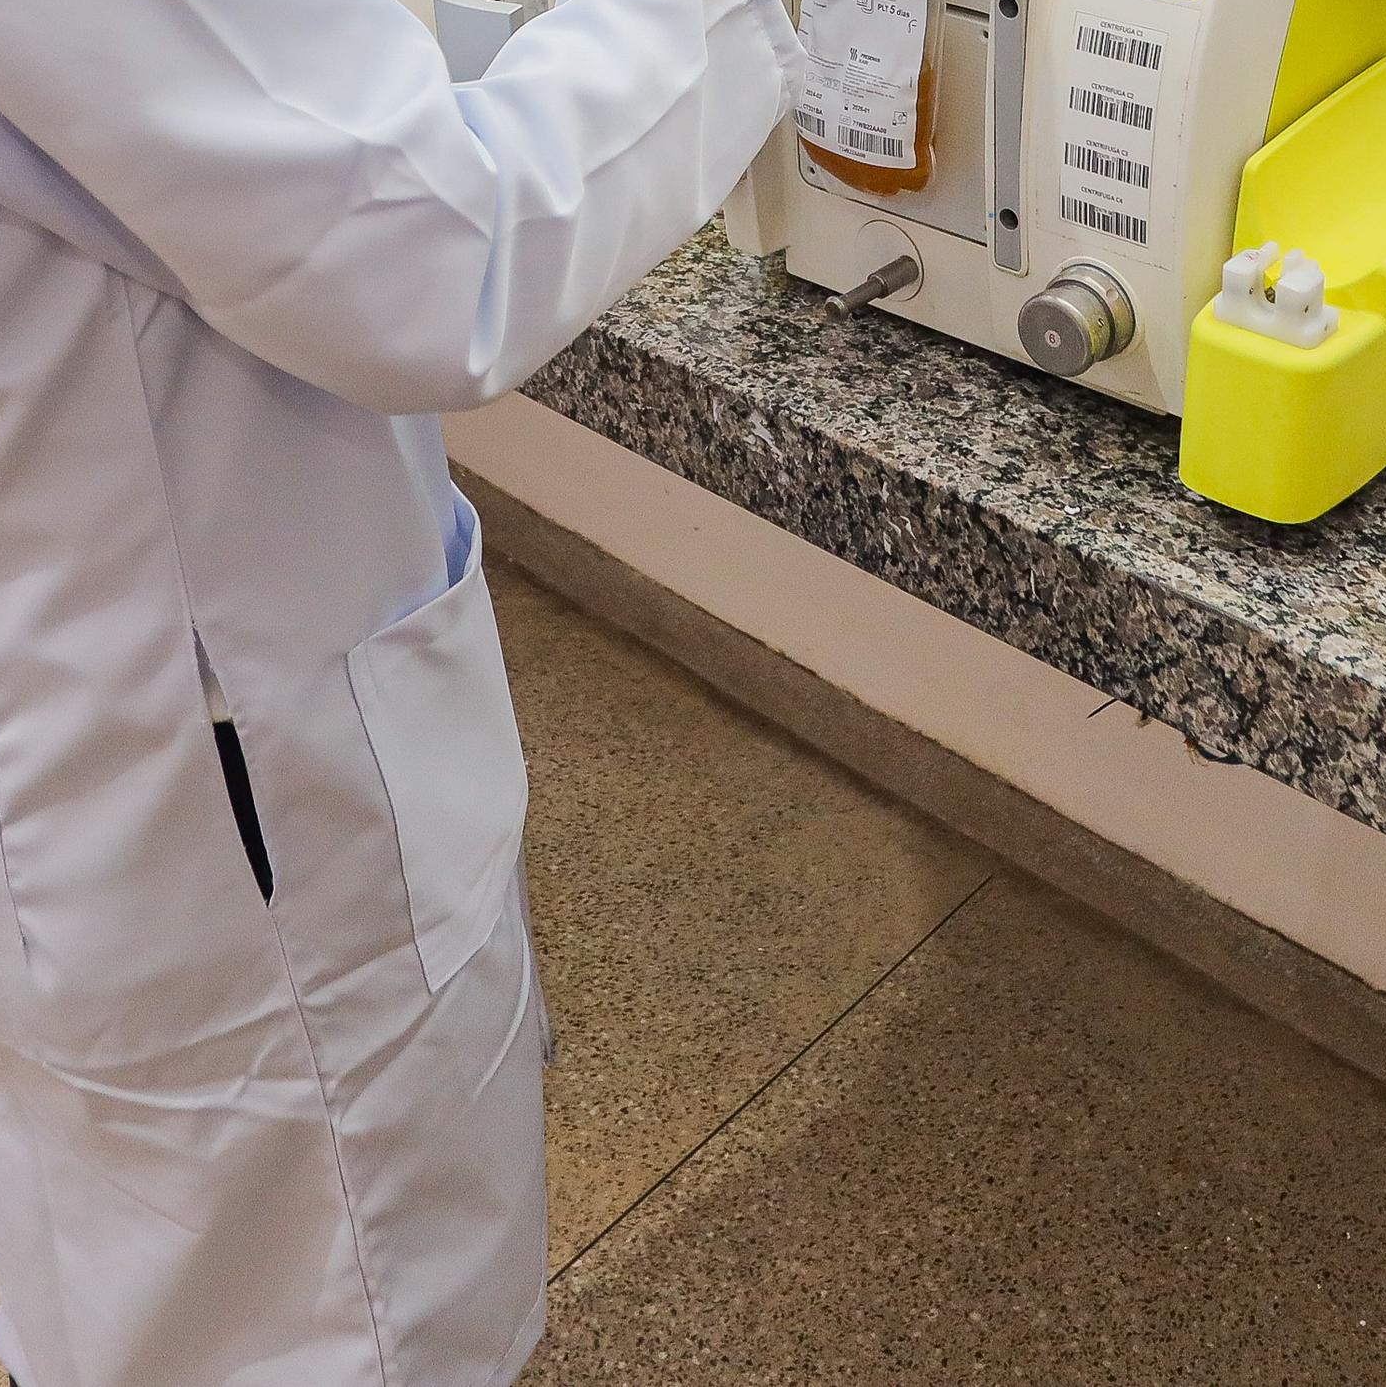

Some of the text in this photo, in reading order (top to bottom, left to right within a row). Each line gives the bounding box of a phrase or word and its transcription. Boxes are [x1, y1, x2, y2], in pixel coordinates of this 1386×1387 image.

[877, 3, 911, 18] PLT 5 dias
[1100, 20, 1135, 34] CENTRIFUGA
[1091, 82, 1126, 97] CENTRIFUGA
[1127, 91, 1135, 100] C2
[1085, 139, 1120, 154] CENTRIFUGA
[1080, 185, 1115, 201] CENTRIFUGA
